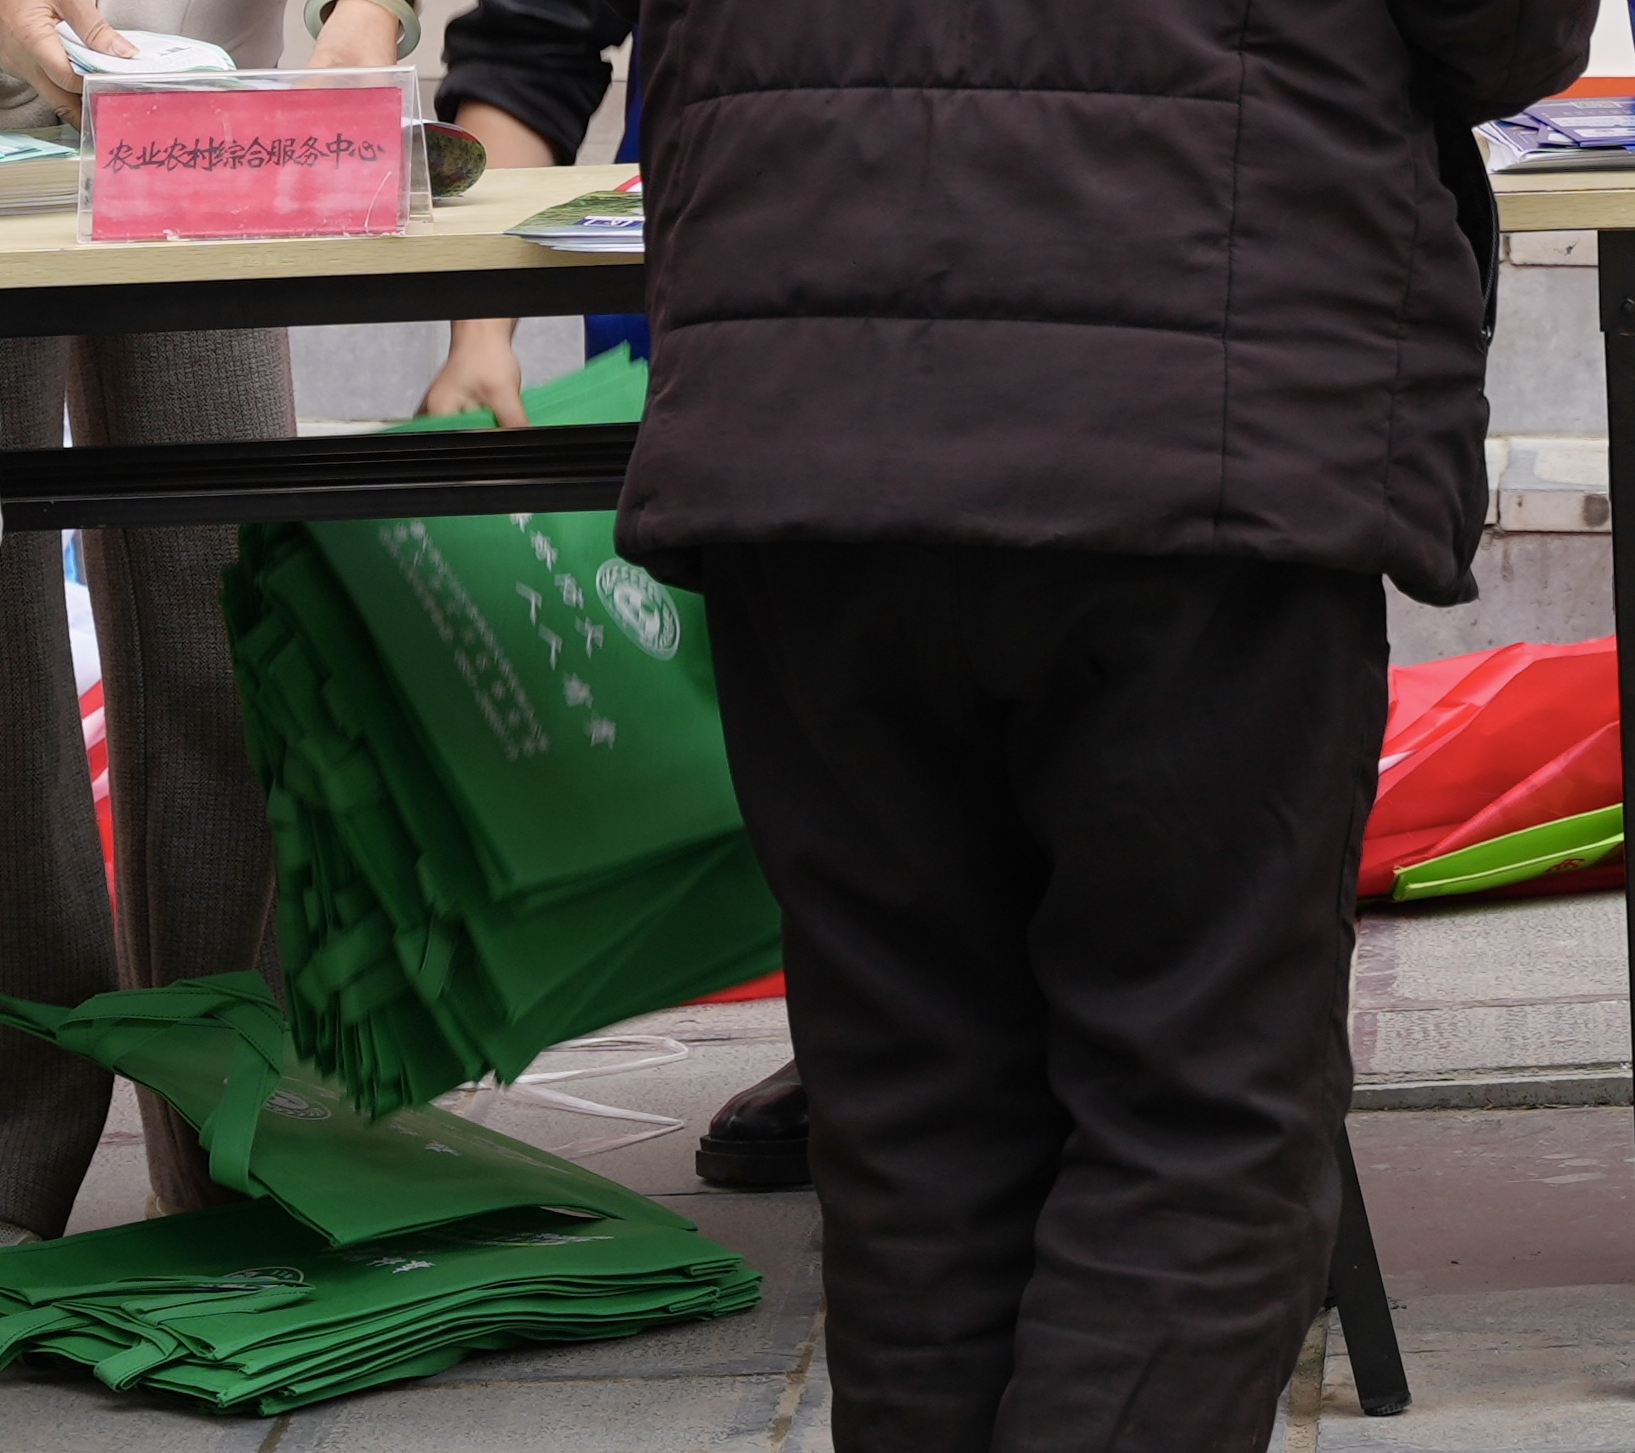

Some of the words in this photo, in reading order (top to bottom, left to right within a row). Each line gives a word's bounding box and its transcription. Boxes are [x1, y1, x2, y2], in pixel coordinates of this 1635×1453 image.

[103, 133, 386, 174] 农业农村综合服务中心
